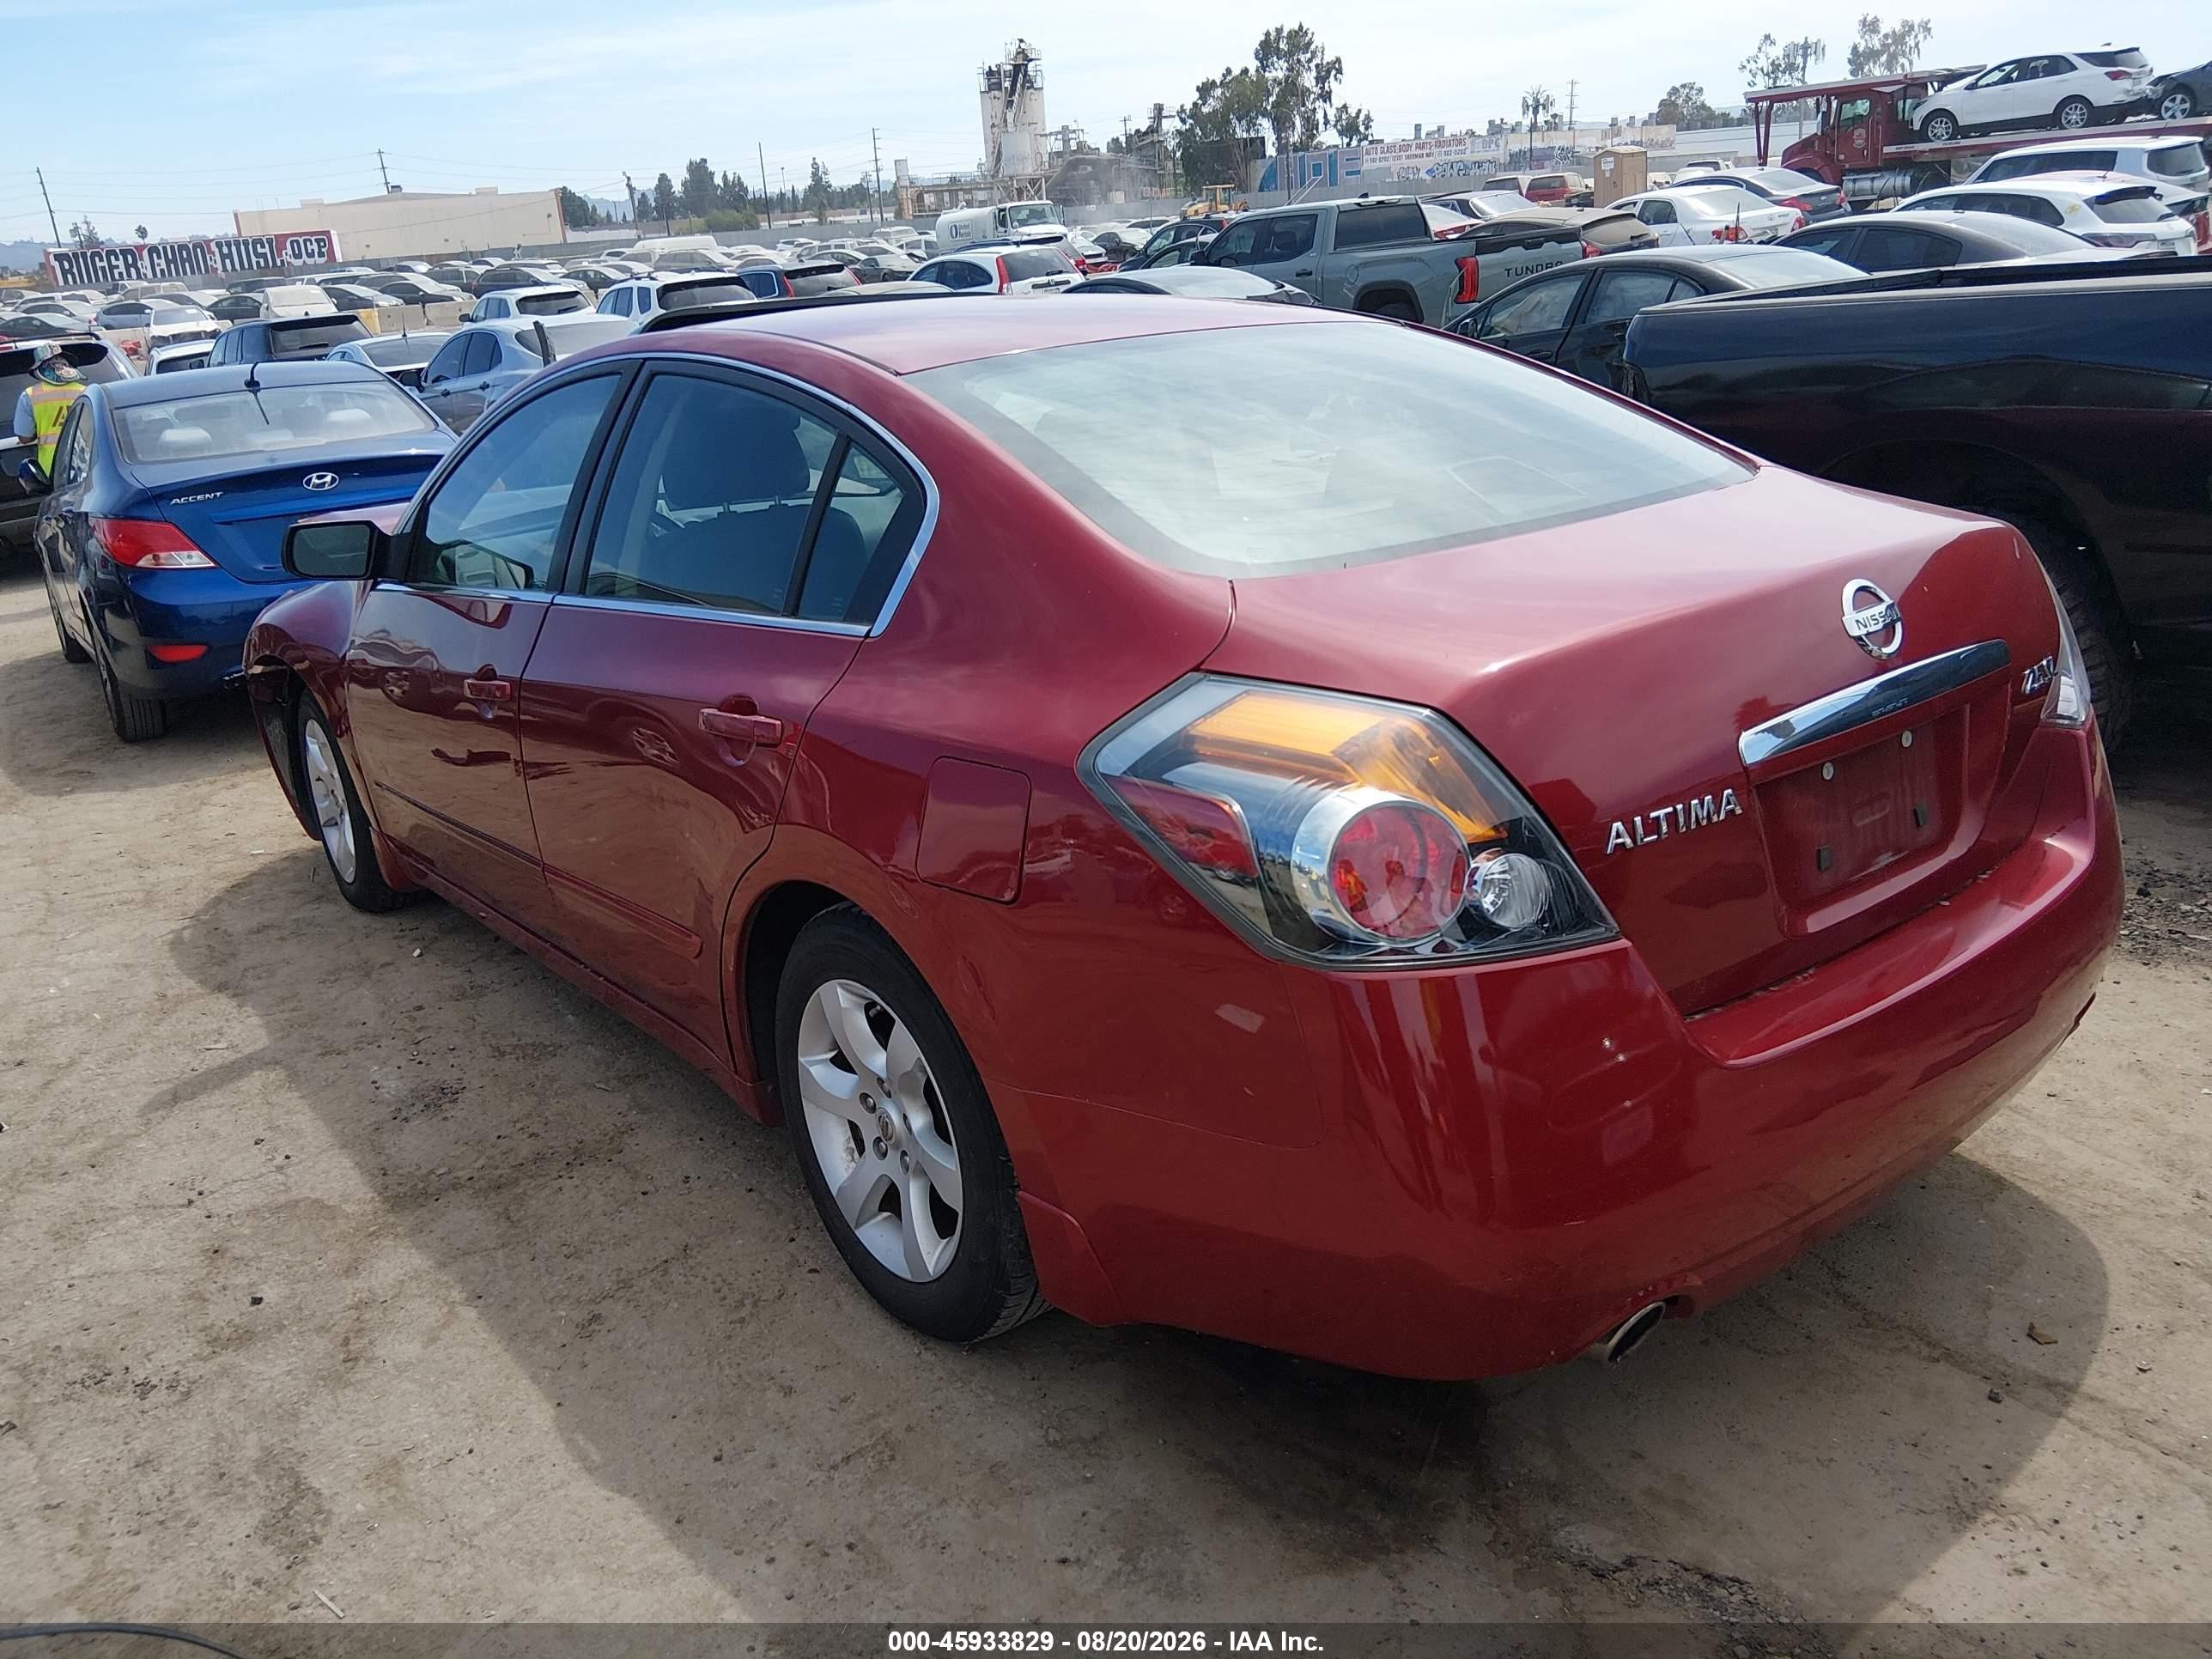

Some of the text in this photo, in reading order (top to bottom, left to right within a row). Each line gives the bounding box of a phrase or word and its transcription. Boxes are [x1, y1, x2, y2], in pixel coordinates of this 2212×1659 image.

[1364, 146, 1378, 156] AUTO
[170, 491, 224, 506] ACCENT
[1605, 787, 1743, 855] ALTIMA
